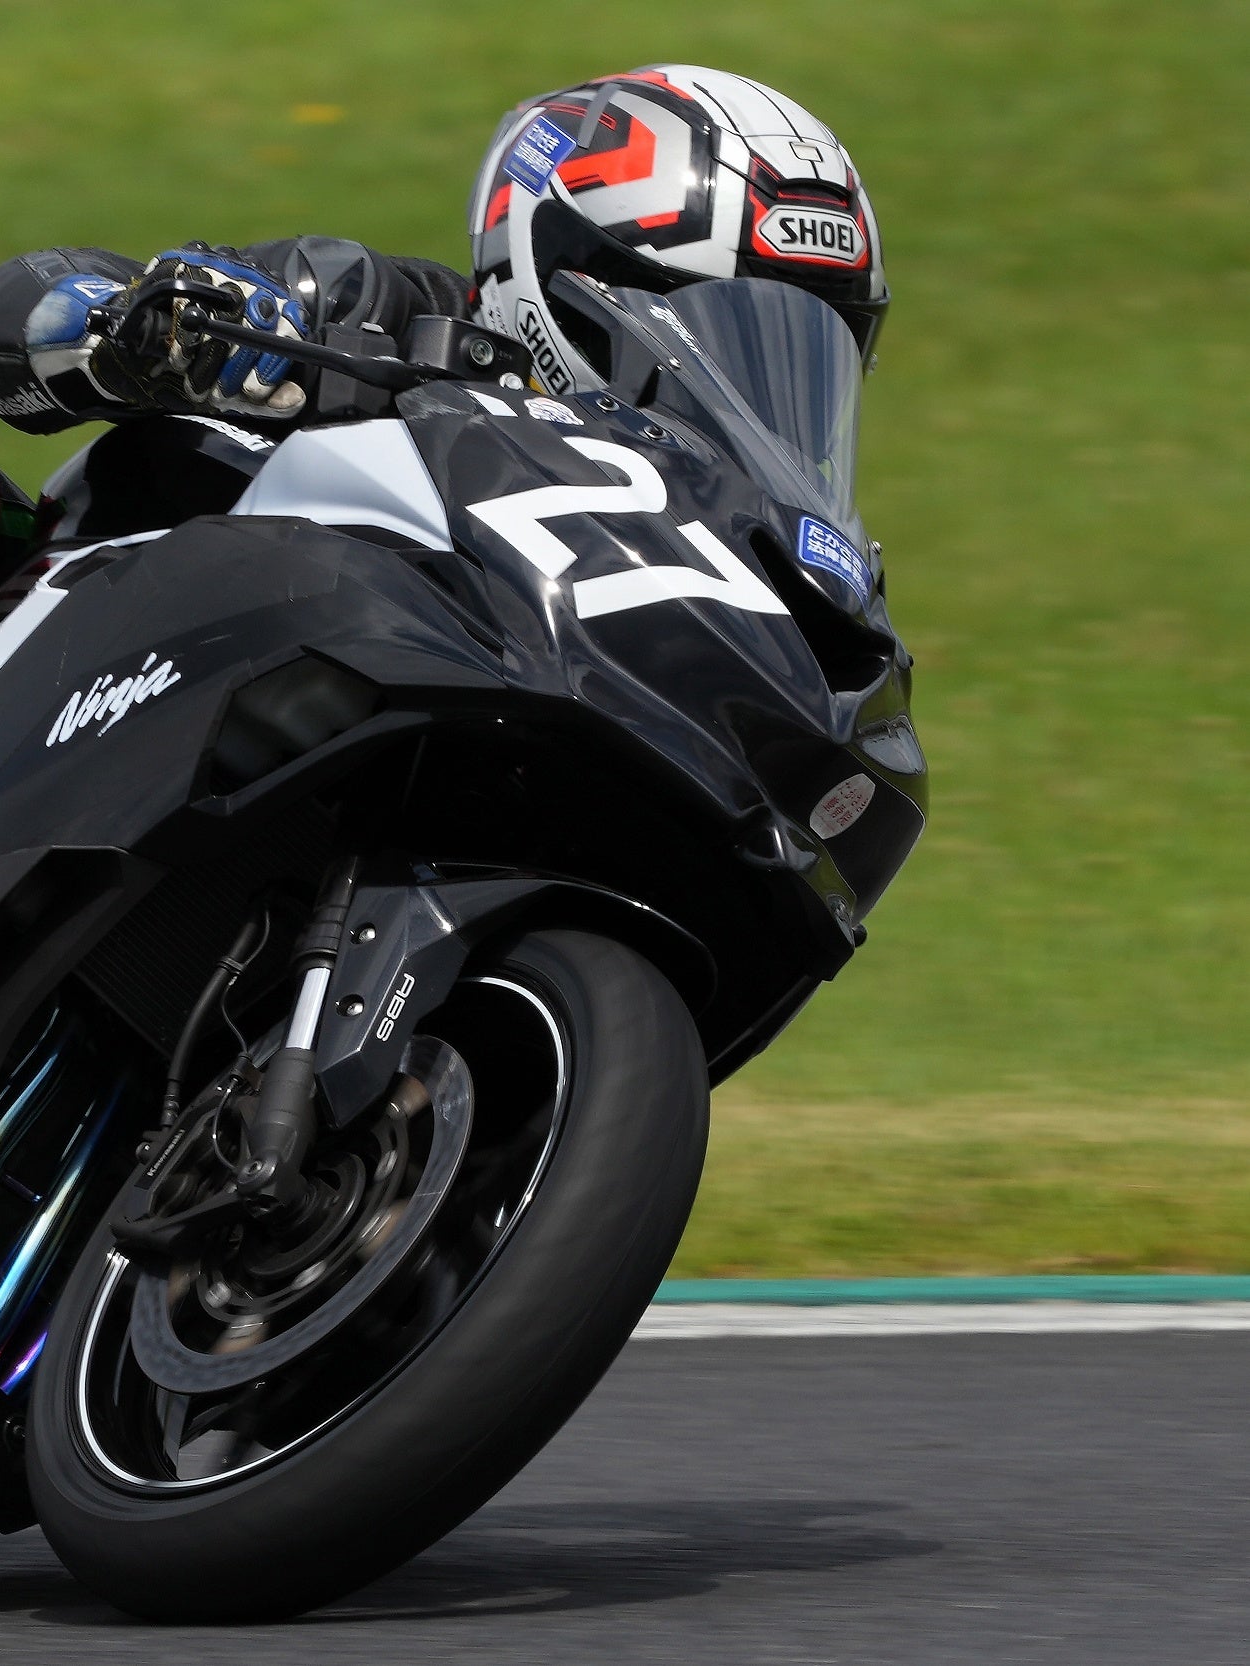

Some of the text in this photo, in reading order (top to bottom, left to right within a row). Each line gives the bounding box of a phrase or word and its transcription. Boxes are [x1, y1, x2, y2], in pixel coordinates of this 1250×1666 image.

[779, 217, 854, 254] SHOEI
[519, 310, 571, 395] SHOEI
[466, 437, 791, 619] 27
[45, 652, 182, 748] Ninja
[376, 973, 415, 1042] ABS
